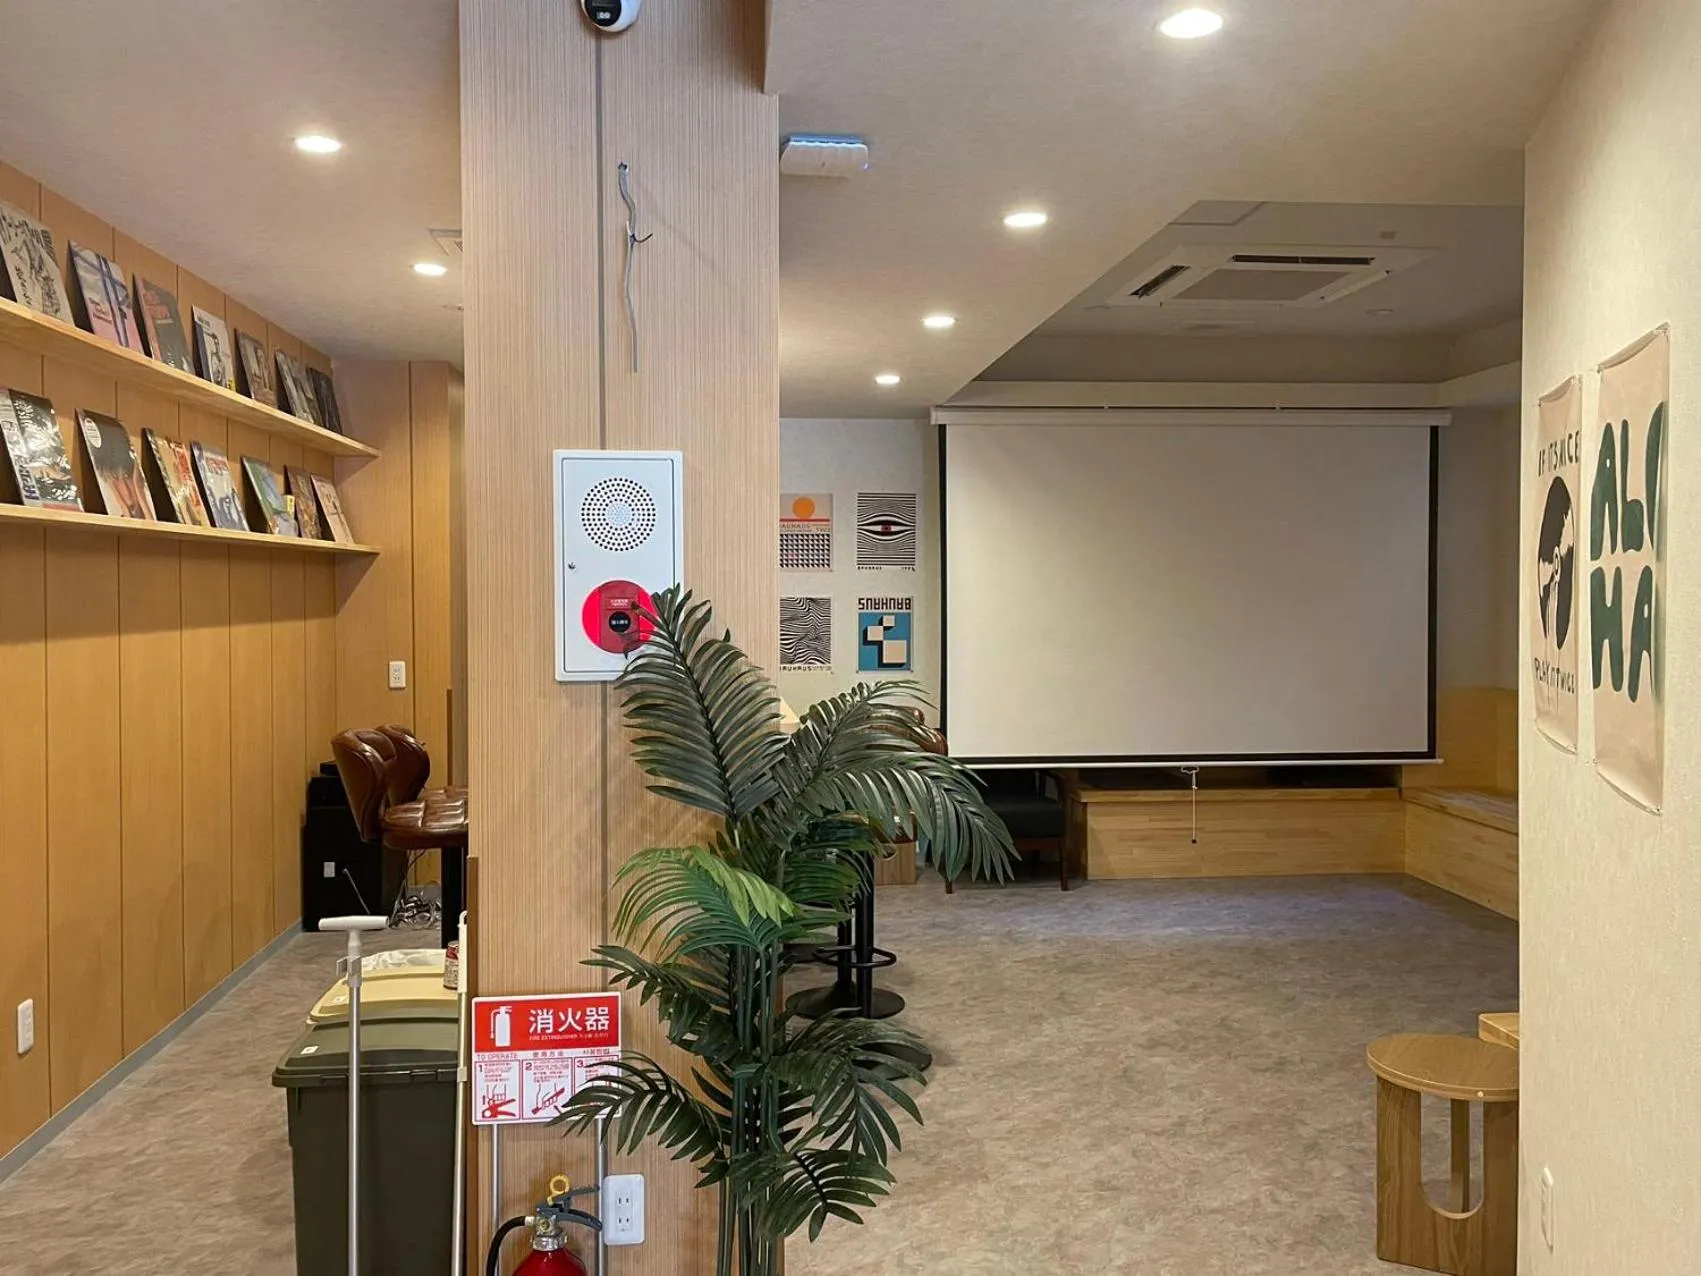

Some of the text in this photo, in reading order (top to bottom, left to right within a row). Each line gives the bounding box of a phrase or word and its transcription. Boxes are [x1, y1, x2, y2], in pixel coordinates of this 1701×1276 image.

[858, 597, 912, 610] BAUHAUS
[1590, 566, 1656, 703] HA
[529, 1007, 610, 1034] 消火器
[487, 1052, 518, 1061] OPERATE
[478, 1064, 483, 1073] 1
[525, 1062, 533, 1071] 2
[576, 1060, 584, 1068] 3
